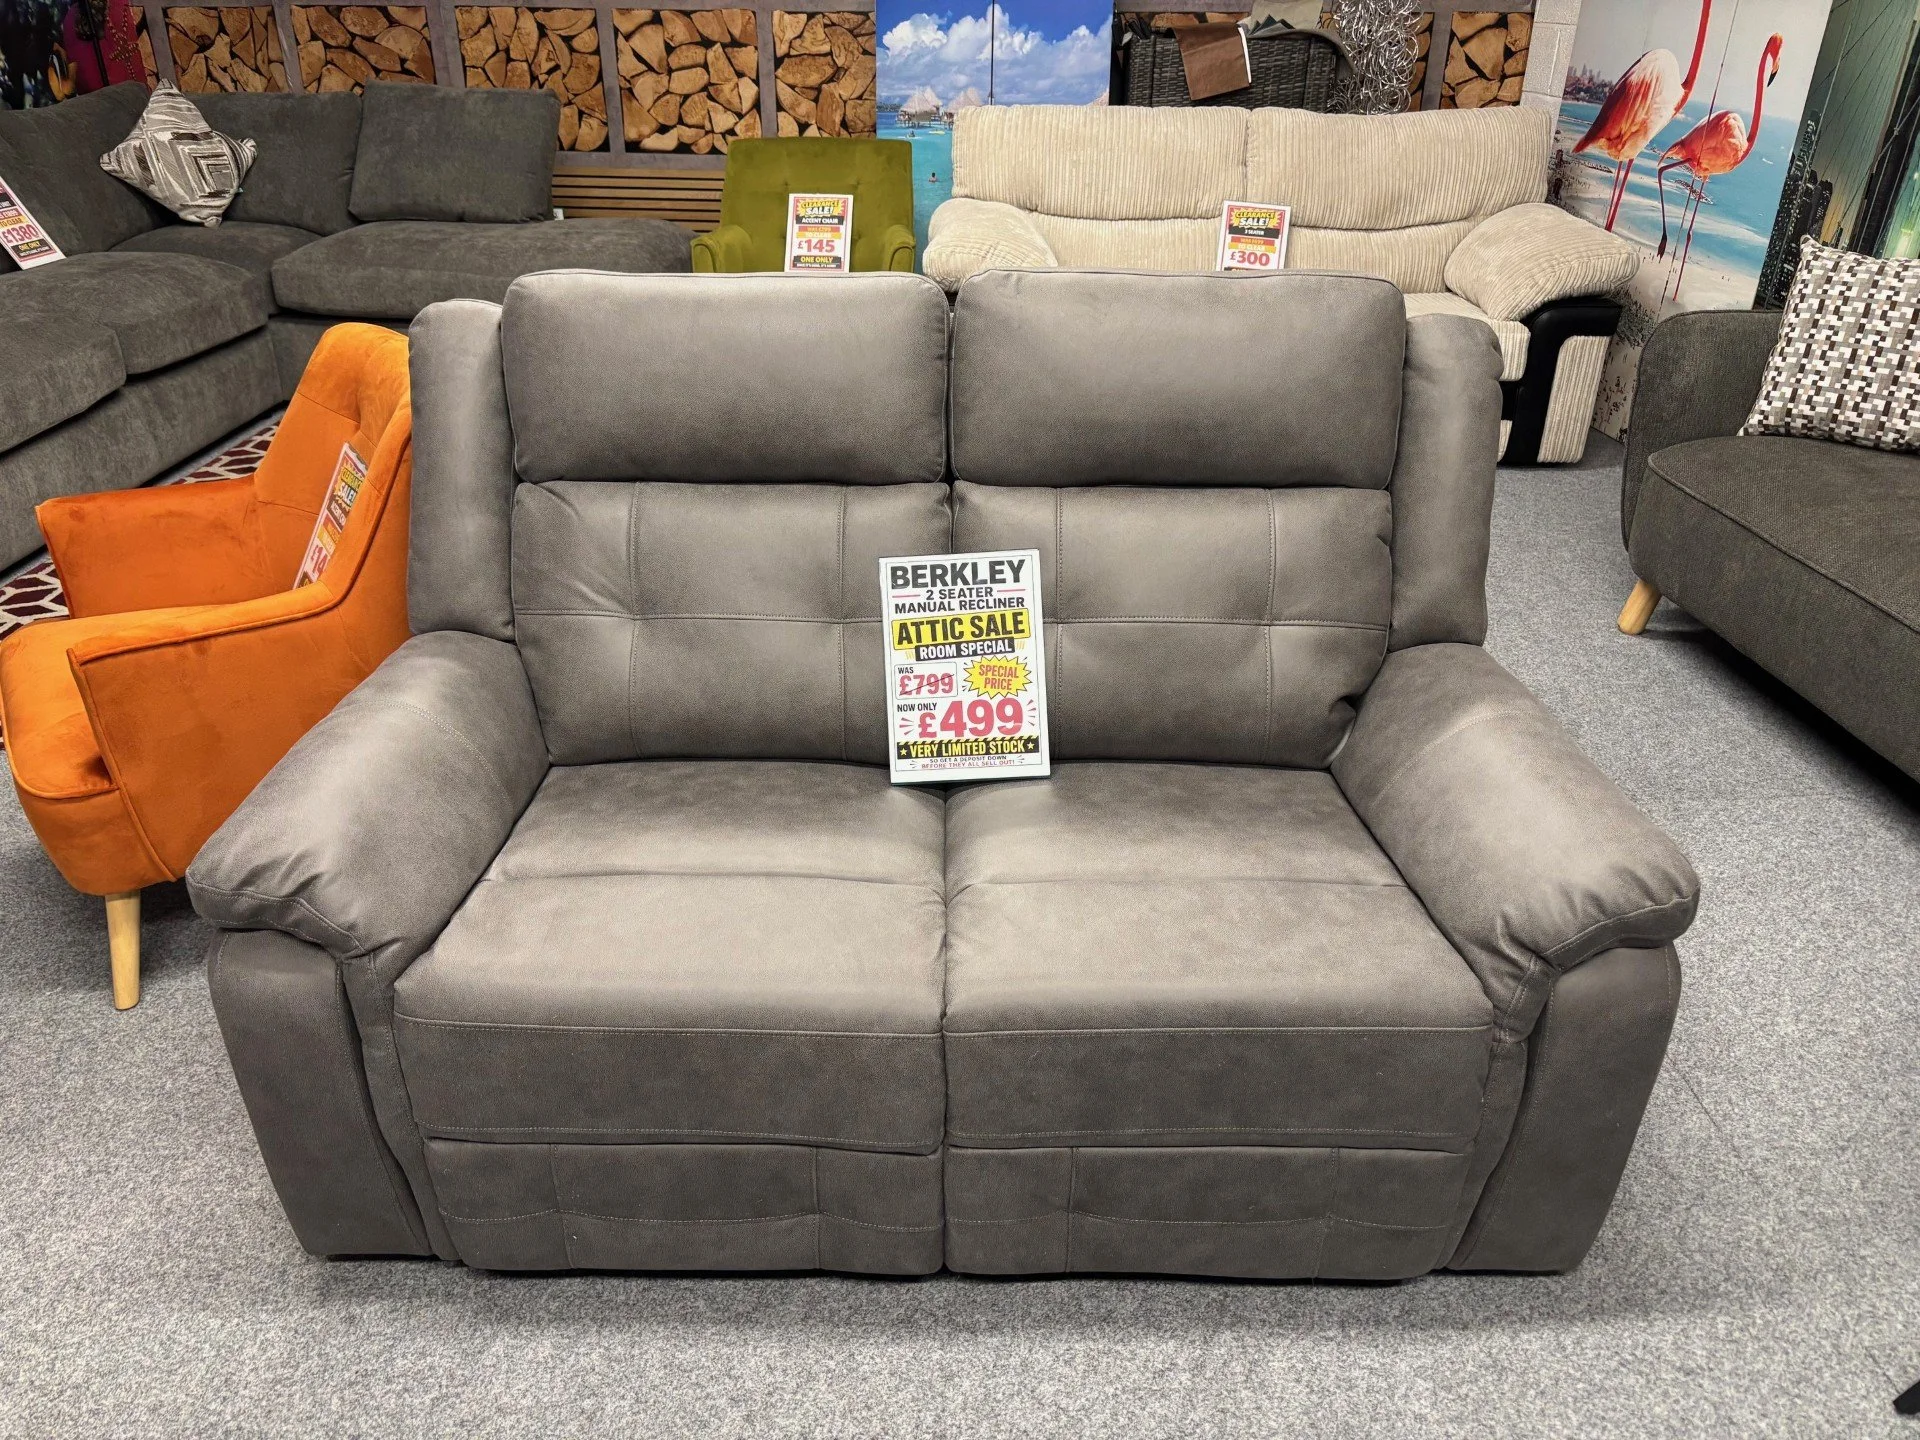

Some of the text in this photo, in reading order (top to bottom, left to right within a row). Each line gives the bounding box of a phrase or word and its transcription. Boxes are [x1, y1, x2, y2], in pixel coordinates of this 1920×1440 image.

[801, 200, 839, 208] CLEARANCE
[806, 206, 834, 214] SALE!
[8, 218, 22, 226] CLEAR
[1240, 218, 1270, 226] SALE!
[2, 224, 40, 244] £1380
[798, 238, 835, 252] £145
[1230, 250, 1270, 266] £300
[341, 467, 362, 489] CLEARANC
[890, 559, 1026, 590] BERKLEY
[926, 587, 994, 600] 2 SEATER
[894, 597, 1025, 614] MANUAL RECLINER
[898, 612, 1026, 646] ATTIC SALE
[920, 638, 1012, 660] ROOM SPECIAL
[898, 666, 914, 674] WAS
[978, 664, 1020, 678] SPECIAL
[900, 673, 954, 696] £799
[984, 676, 1013, 690] PRICE
[897, 702, 938, 712] NOW ONLY
[918, 698, 1024, 738] £499
[910, 739, 1026, 758] VERY LIMITED STOCK
